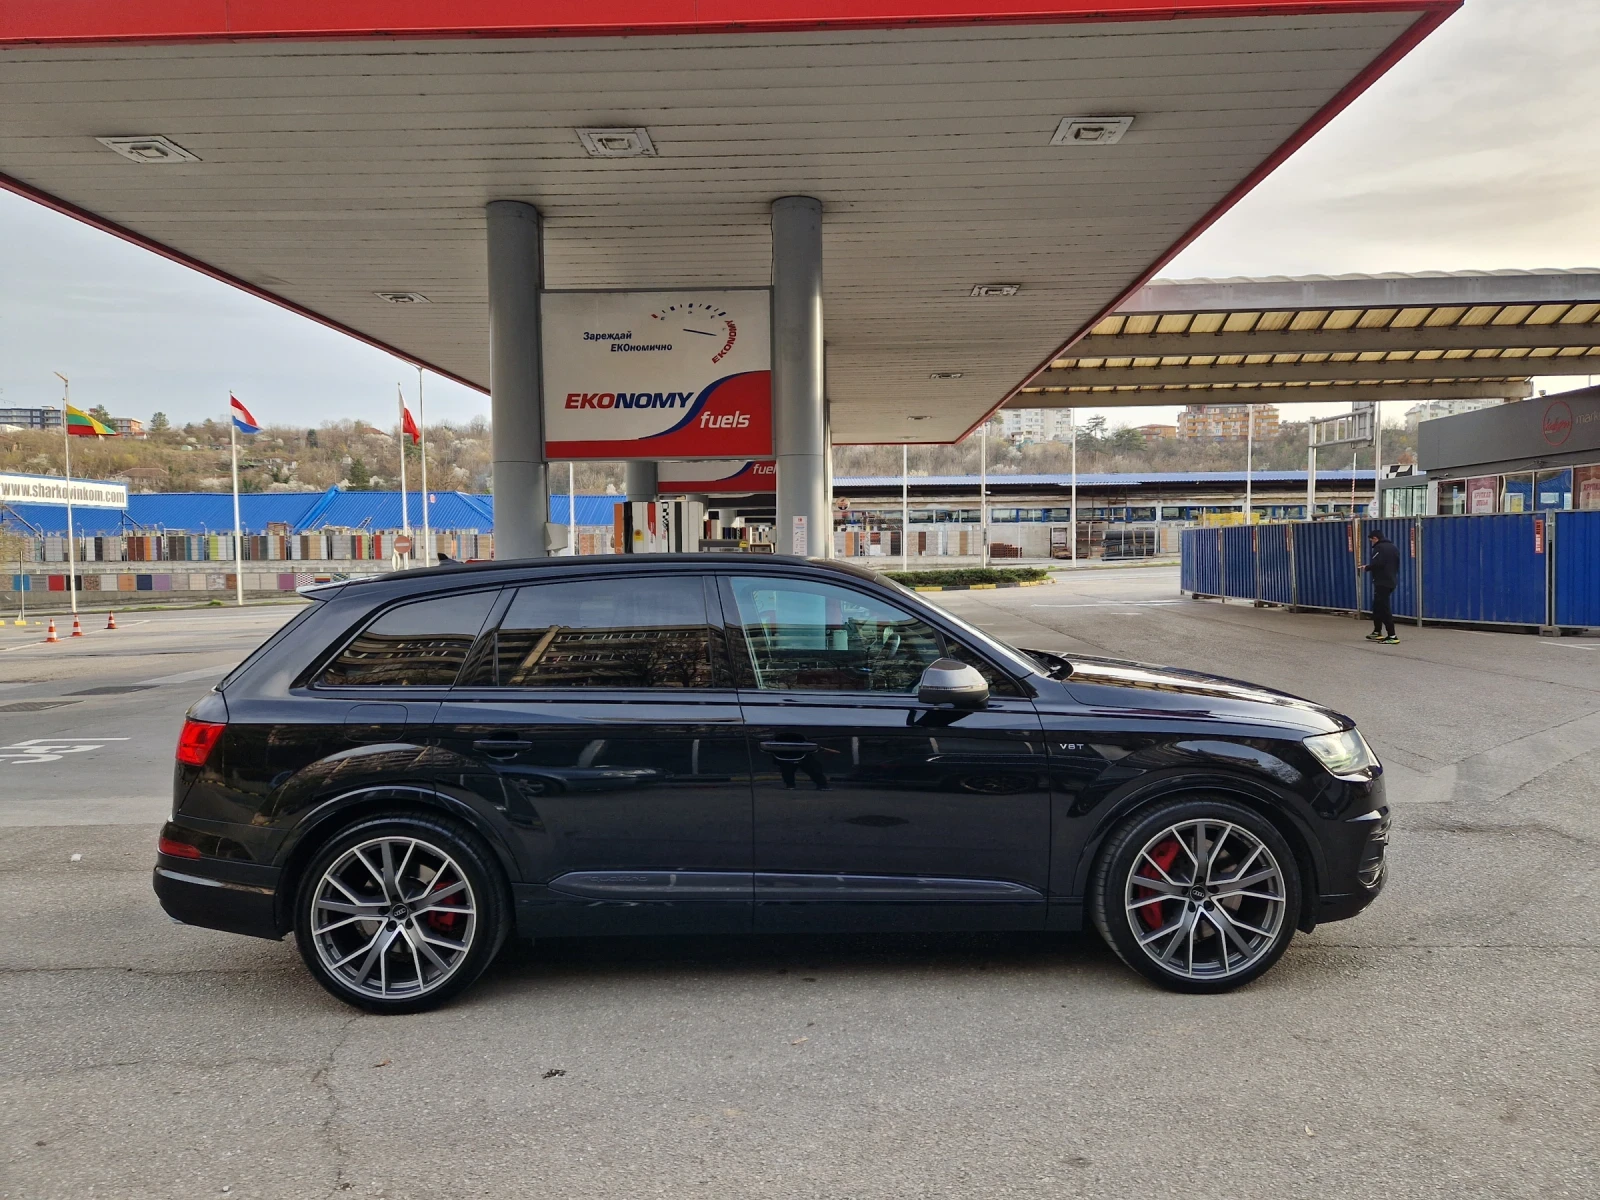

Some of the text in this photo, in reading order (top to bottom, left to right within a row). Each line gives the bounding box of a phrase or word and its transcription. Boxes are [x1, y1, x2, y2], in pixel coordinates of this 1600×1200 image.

[582, 330, 633, 342] Зареждай
[711, 319, 737, 364] EKONOMY
[564, 392, 695, 409] EKONOMY
[700, 410, 751, 429] fuels
[1576, 410, 1600, 425] mark
